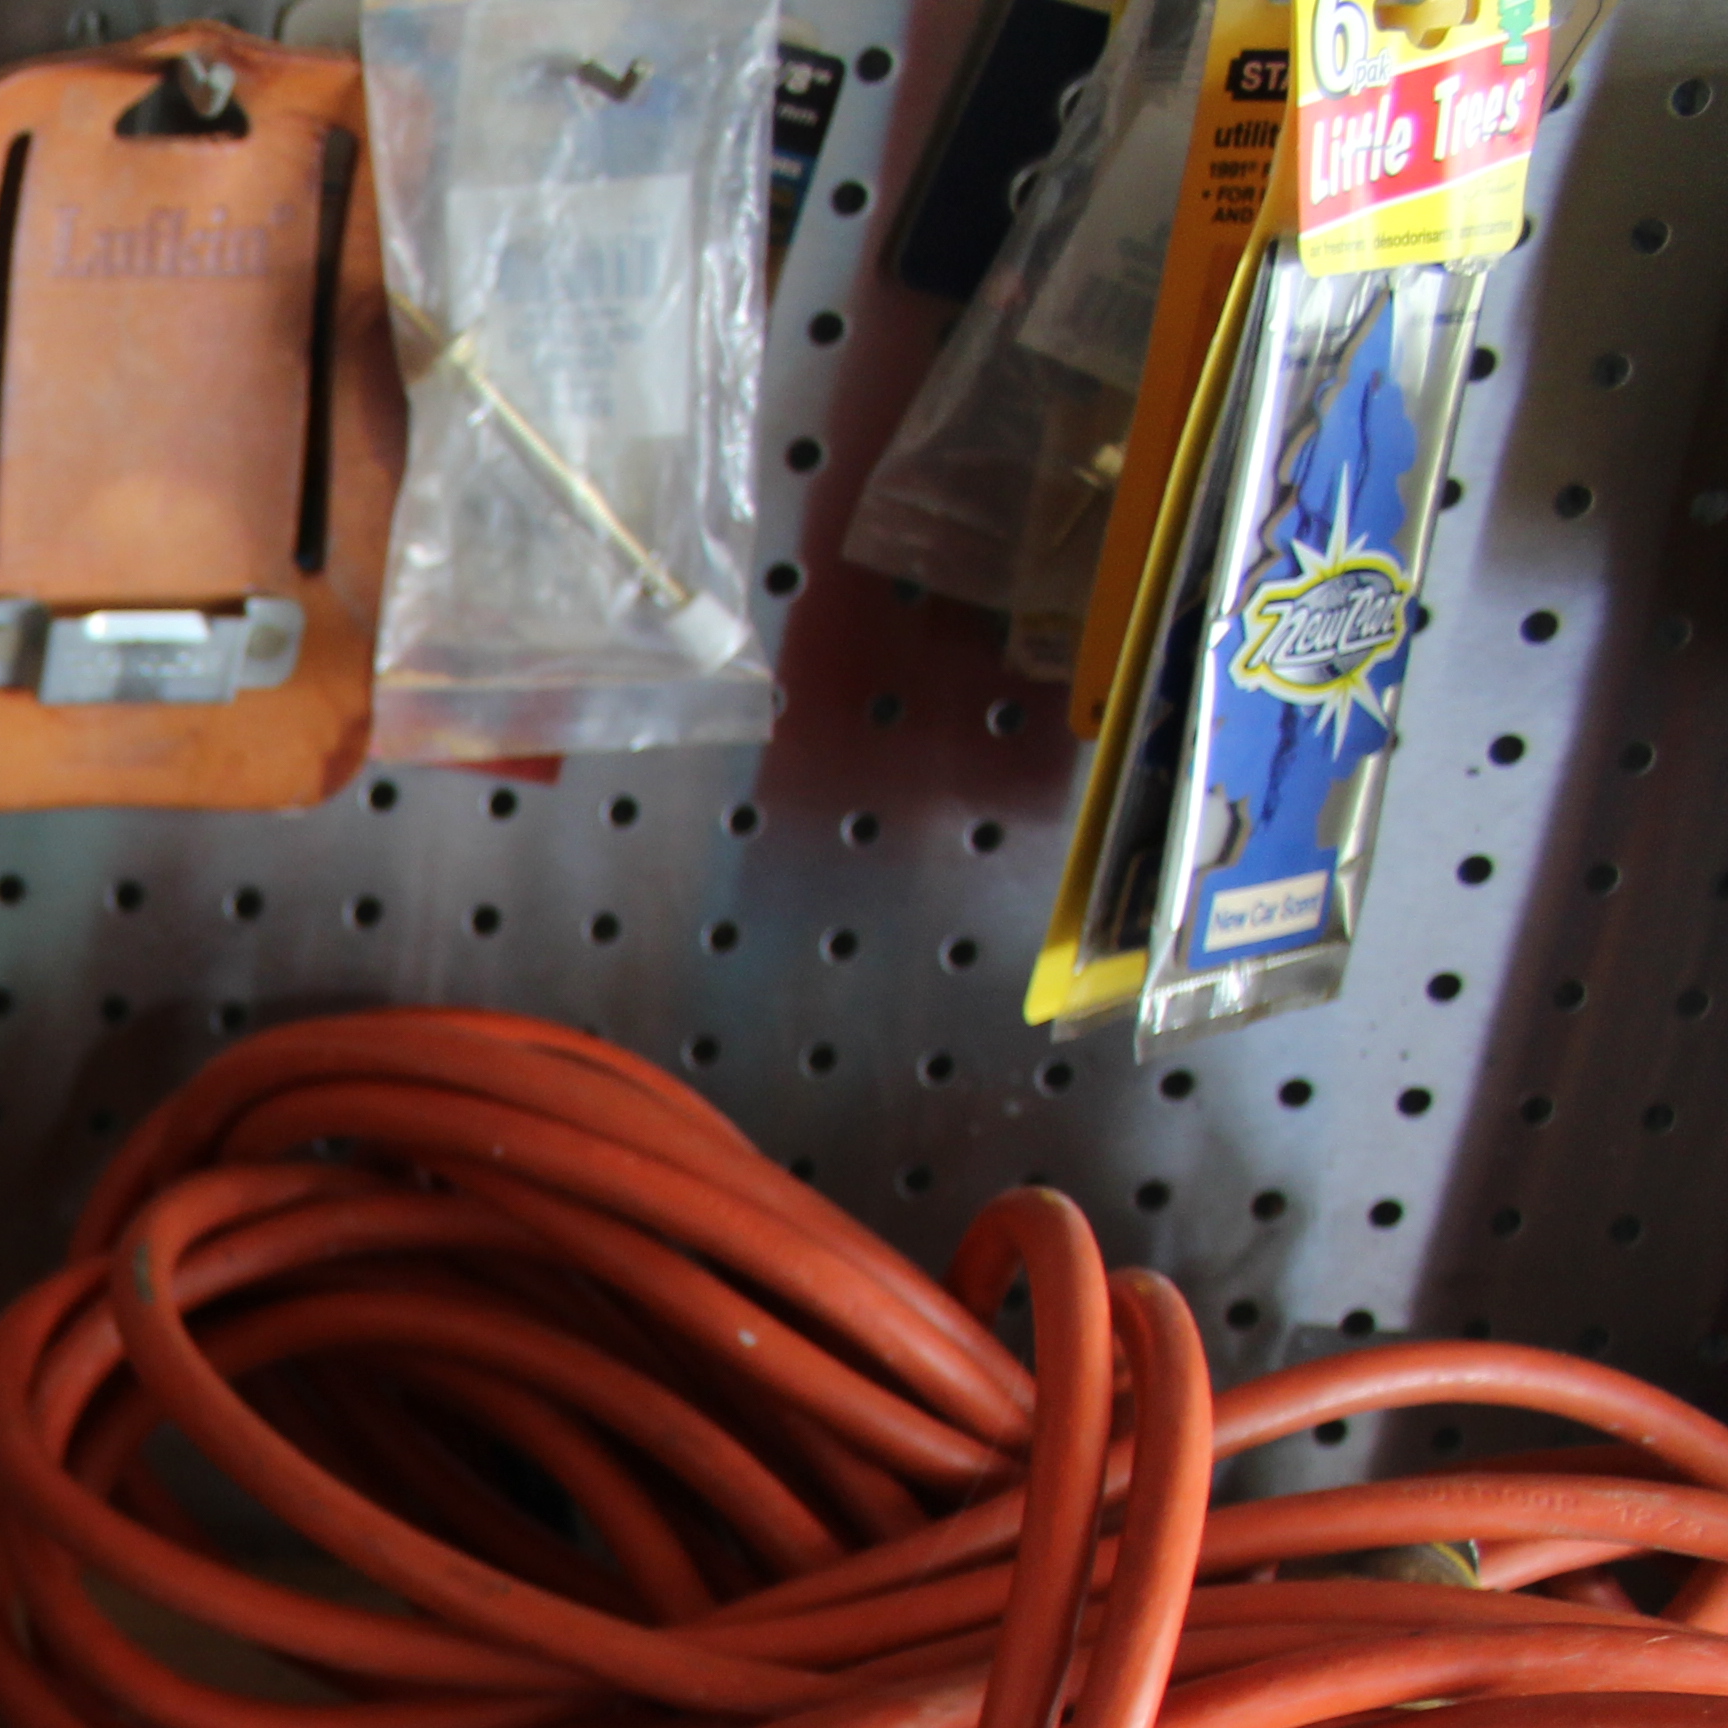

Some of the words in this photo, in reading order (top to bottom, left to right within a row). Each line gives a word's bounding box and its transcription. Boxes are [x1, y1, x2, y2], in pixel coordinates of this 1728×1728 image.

[1312, 0, 1369, 99] 6
[1351, 51, 1392, 93] pak
[1309, 93, 1414, 206] Little
[1432, 75, 1527, 162] Trees
[1213, 906, 1245, 931] New
[1250, 902, 1277, 927] Car
